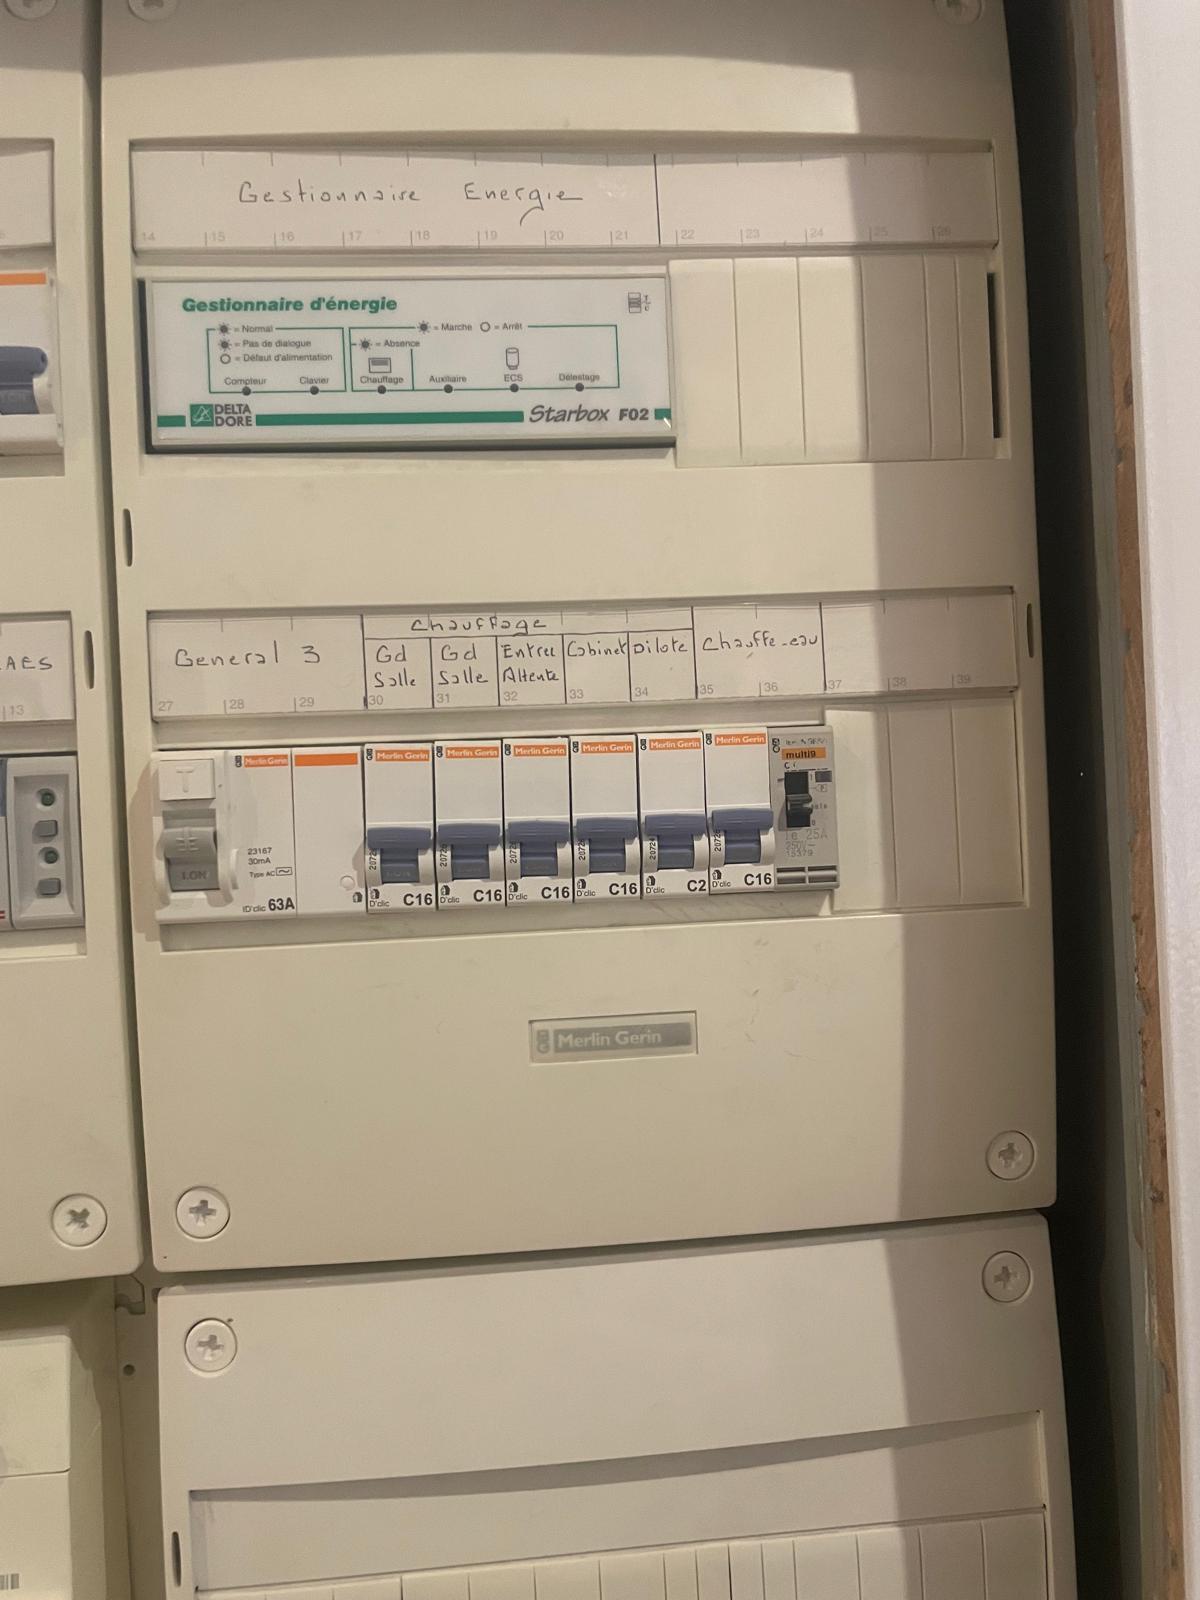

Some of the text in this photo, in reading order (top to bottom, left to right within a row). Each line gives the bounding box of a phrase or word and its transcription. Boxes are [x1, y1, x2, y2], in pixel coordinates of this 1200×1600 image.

[238, 179, 584, 227] Gestionnaire Energie
[211, 231, 225, 242] 15
[281, 230, 295, 242] 16
[349, 230, 362, 242] 17
[416, 229, 430, 241] 18
[485, 229, 498, 241] 19
[550, 229, 564, 241] 20
[615, 229, 629, 241] 21
[680, 228, 695, 240] 22
[182, 296, 398, 314] Gestionnaire d'énergie
[242, 325, 273, 334] Normal
[441, 323, 473, 332] Marche
[502, 322, 523, 331] Arrêt
[242, 339, 312, 350] Pas de dialogue
[383, 338, 421, 348] Absence
[242, 352, 333, 363] Défaut d'alimentation
[224, 376, 267, 387] Compteur
[299, 375, 329, 386] Clavier
[359, 375, 404, 386] Chauffage
[429, 374, 467, 384] Auxiliaire
[503, 373, 524, 383] ECS
[558, 371, 600, 383] Délestage
[214, 403, 251, 415] DELTA
[529, 403, 650, 424] Starbox F02
[214, 415, 252, 427] DORE
[175, 640, 321, 667] General 3
[376, 644, 407, 663] Gd
[441, 643, 477, 661] Gd
[0, 655, 53, 671] AES
[374, 667, 416, 688] Salle
[438, 665, 488, 686] Salle
[700, 685, 714, 695] 35
[764, 682, 778, 692] 36
[828, 680, 842, 690] 37
[503, 691, 518, 702] 32
[569, 689, 584, 699] 33
[634, 687, 648, 698] 34
[229, 699, 245, 710] 28
[299, 697, 315, 708] 29
[369, 695, 383, 706] 30
[436, 694, 450, 704] 31
[158, 700, 173, 712] 27
[650, 740, 700, 749] Merlin Gerin
[716, 735, 765, 745] Merlin Gerin
[447, 748, 498, 757] Merlin Gerin
[515, 745, 565, 755] Merlin Gerin
[583, 742, 632, 752] Merlin Gerin
[377, 751, 428, 760] Merlin Gerin
[248, 847, 272, 855] 23167
[248, 857, 271, 865] 30mA
[744, 873, 772, 886] C16
[609, 883, 638, 896] C16
[687, 879, 707, 892] C2
[473, 889, 502, 902] C16
[541, 887, 570, 899] C16
[268, 897, 295, 911] 63A
[403, 893, 433, 906] C16
[558, 1030, 662, 1049] Merlin Gerin
